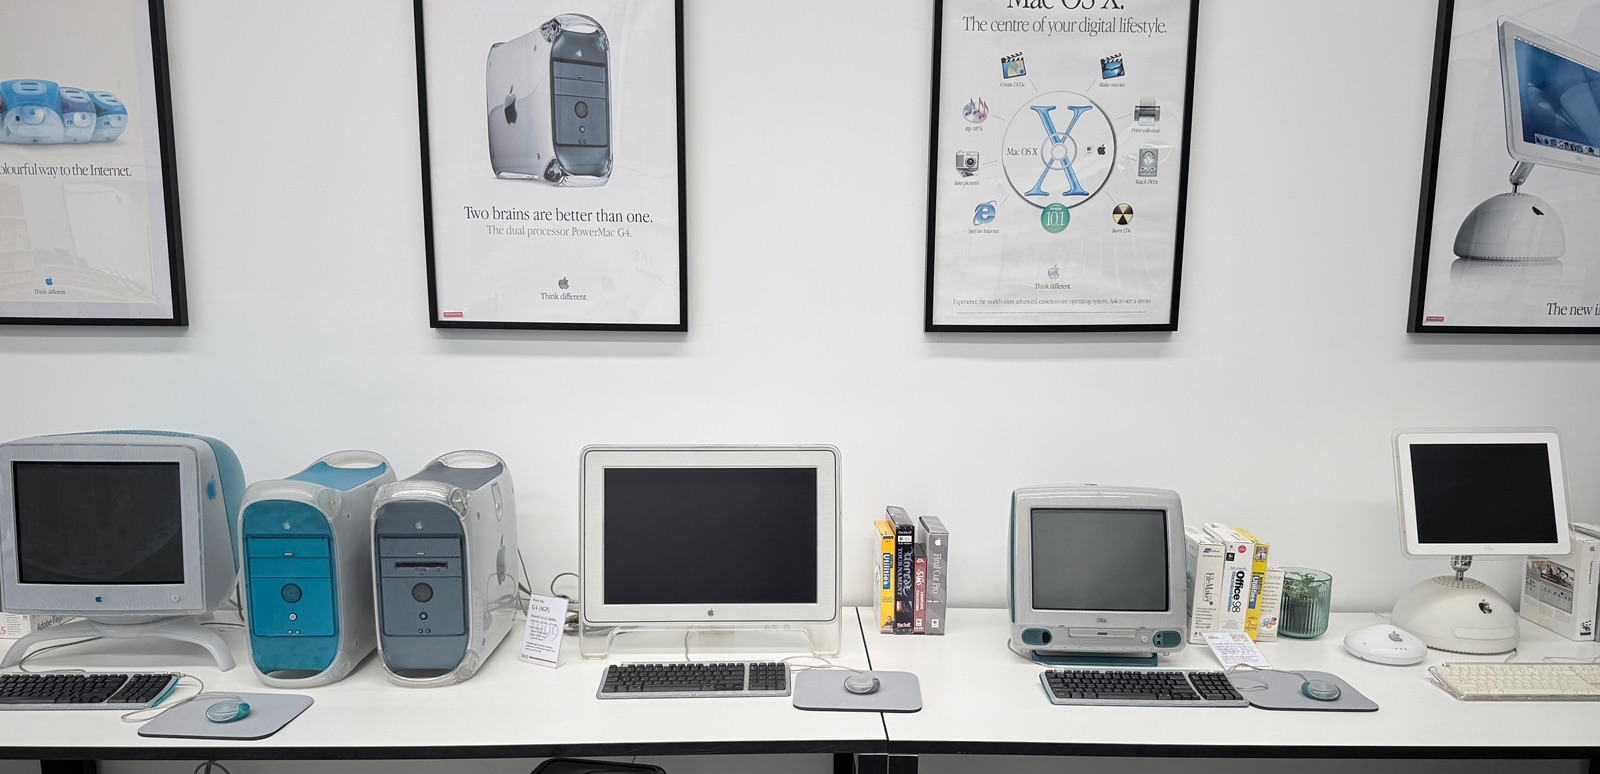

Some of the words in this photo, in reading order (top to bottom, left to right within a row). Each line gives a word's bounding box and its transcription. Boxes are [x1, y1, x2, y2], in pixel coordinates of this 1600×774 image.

[962, 16, 987, 32] The
[990, 18, 1029, 32] centre
[1032, 16, 1047, 32] of
[1048, 20, 1076, 36] your
[1078, 16, 1116, 37] digital
[1119, 17, 1167, 36] lifestyle.
[1006, 148, 1020, 156] Mac
[1021, 148, 1031, 156] OS
[38, 166, 58, 178] way
[60, 166, 71, 176] to
[72, 164, 89, 176] the
[91, 165, 132, 177] Internet.
[464, 206, 489, 220] Two
[492, 206, 530, 221] brains
[533, 210, 552, 221] are
[556, 208, 592, 222] better
[596, 209, 623, 223] than
[626, 212, 653, 223] one.
[487, 225, 504, 235] The
[506, 225, 525, 235] dual
[527, 228, 569, 238] processor
[571, 227, 615, 237] PowerMac
[617, 228, 632, 238] G4.
[1546, 302, 1567, 315] The
[1569, 306, 1593, 315] new
[1204, 573, 1214, 602] FileMaker
[1234, 571, 1245, 600] Office
[1250, 576, 1260, 603] Utilities
[1232, 601, 1242, 613] 98
[37, 619, 52, 630] Adobe
